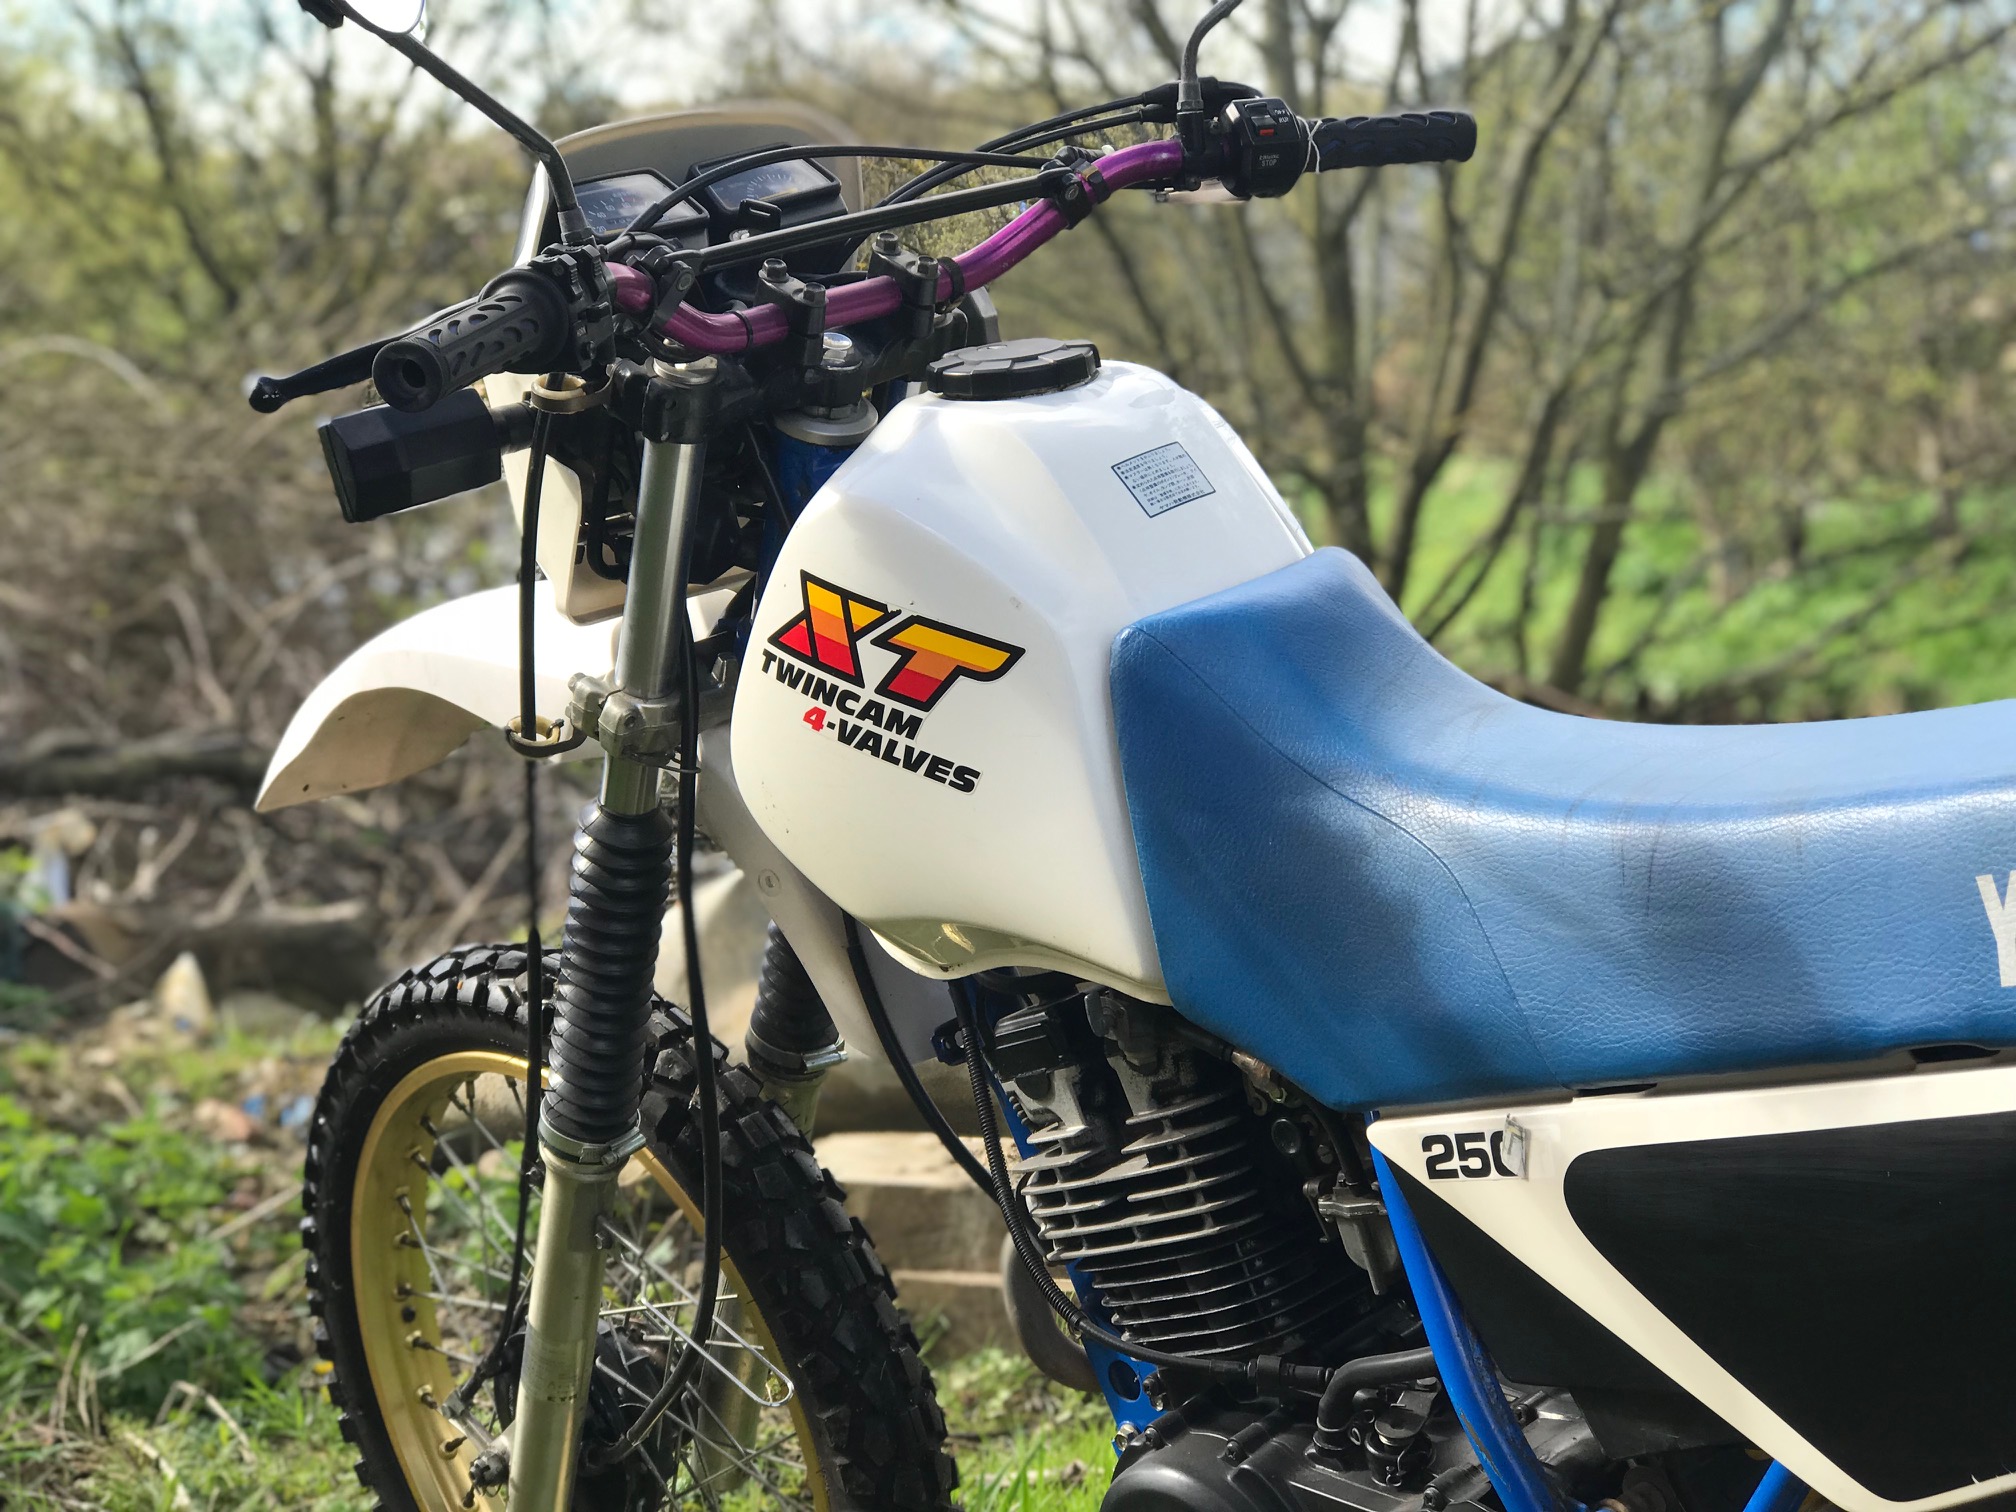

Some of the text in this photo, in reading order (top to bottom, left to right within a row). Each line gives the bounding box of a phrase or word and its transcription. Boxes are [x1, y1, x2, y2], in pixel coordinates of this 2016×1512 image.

[1261, 159, 1277, 167] STOP
[767, 568, 1027, 712] XT
[761, 648, 924, 740] TWINCAM
[803, 706, 981, 793] 4-VALVES
